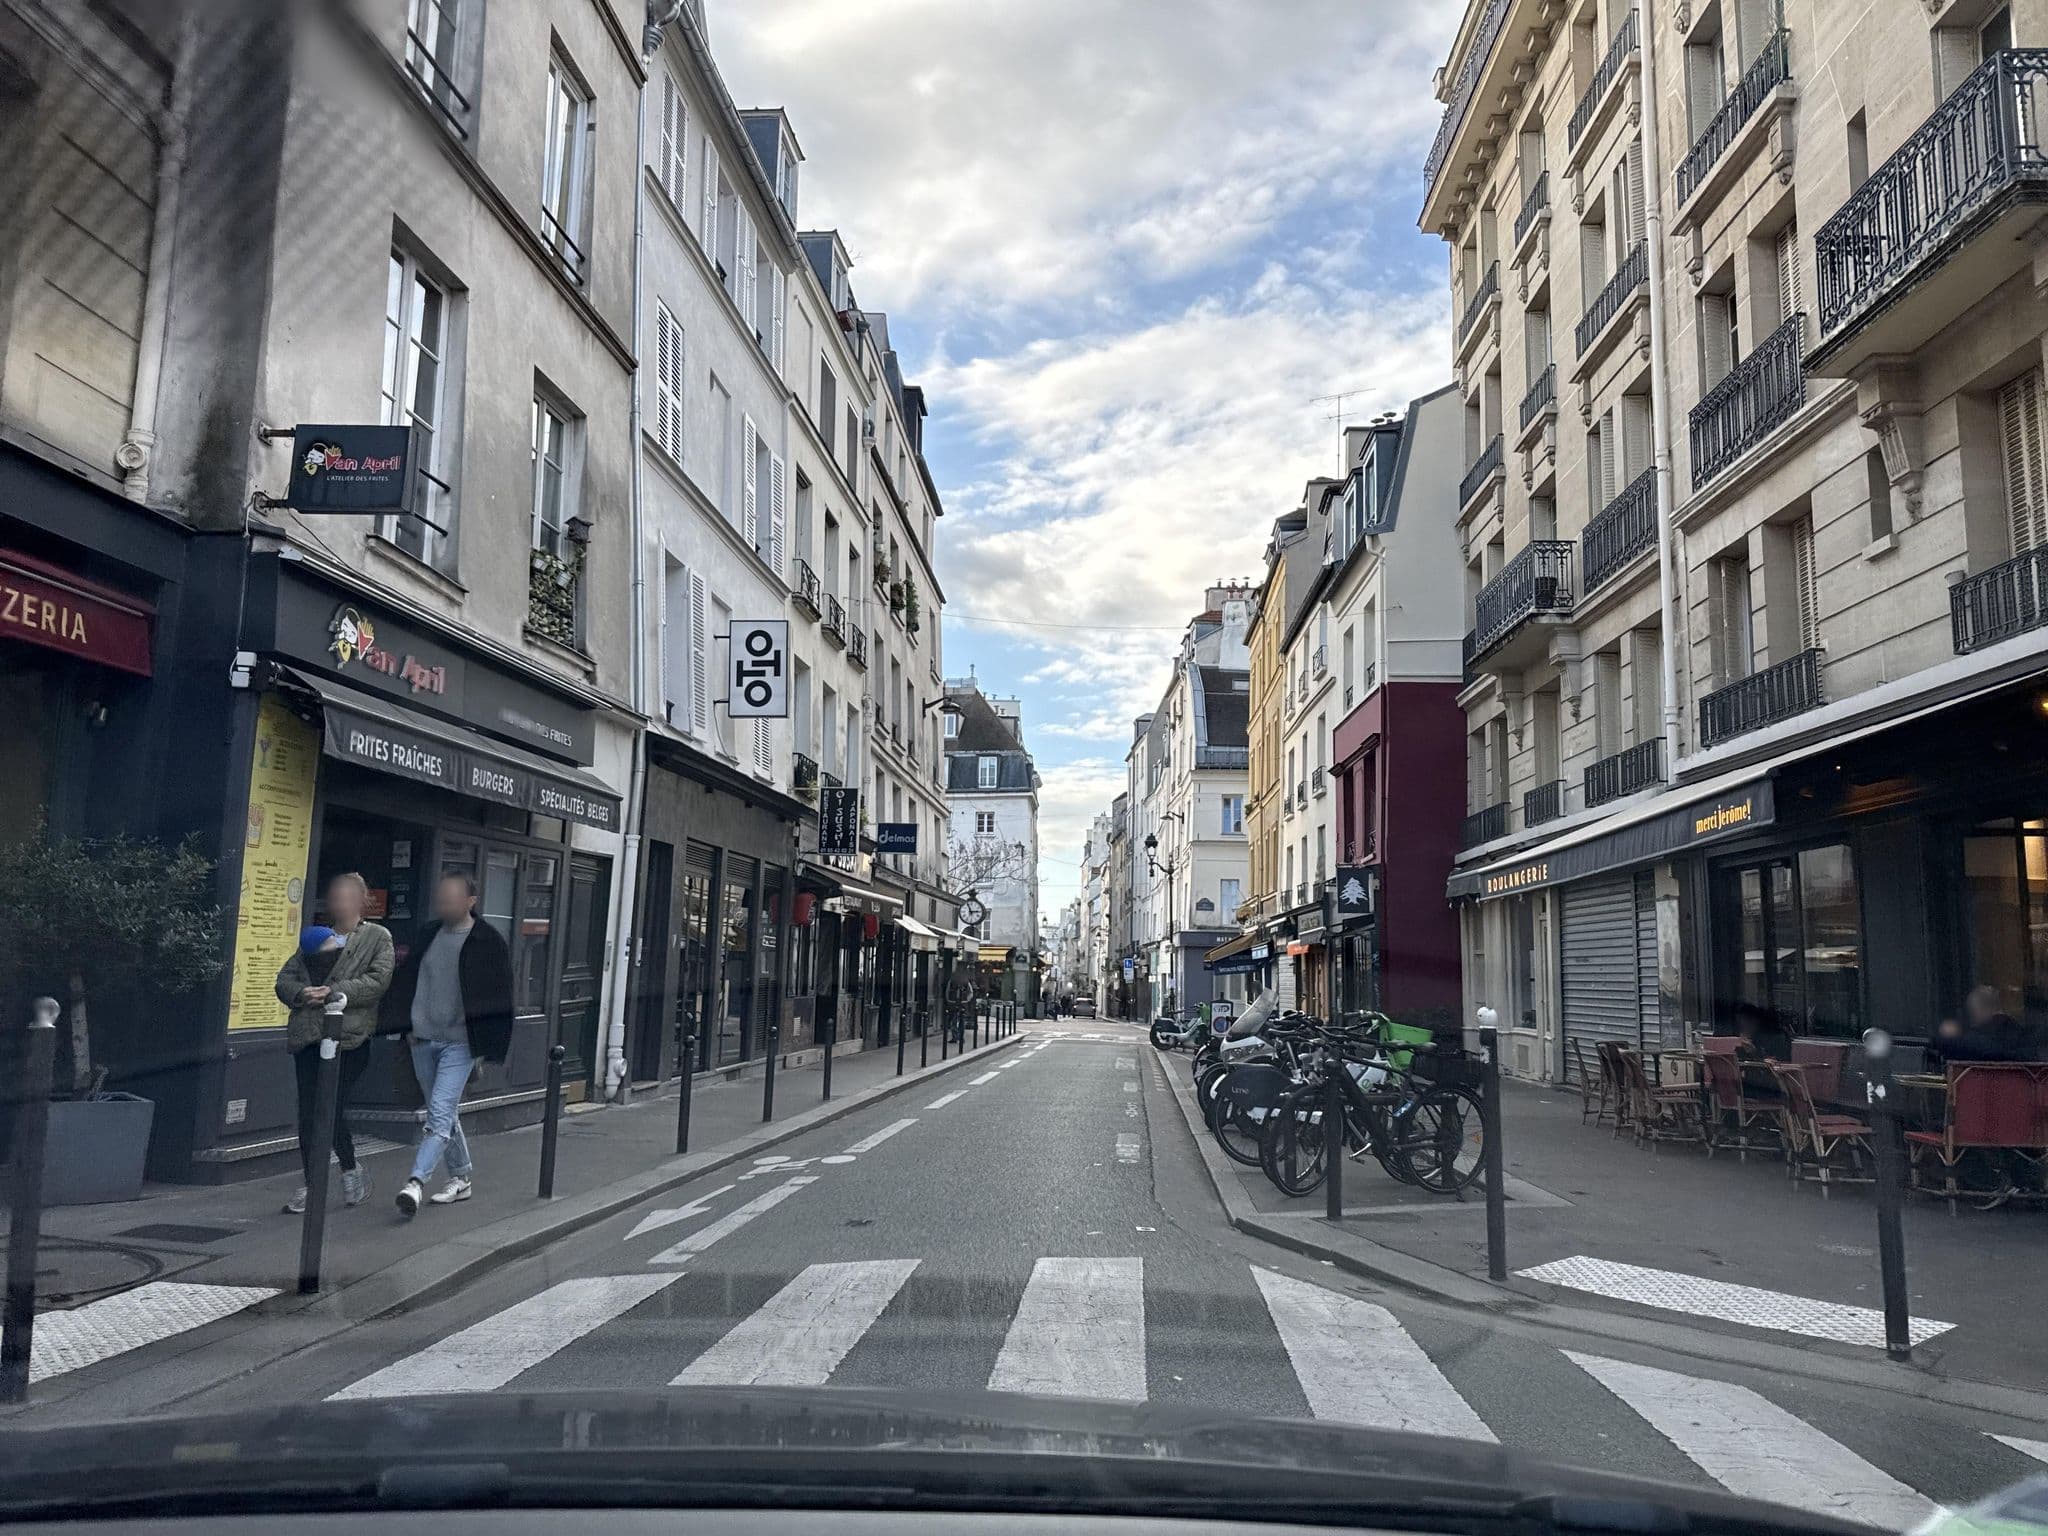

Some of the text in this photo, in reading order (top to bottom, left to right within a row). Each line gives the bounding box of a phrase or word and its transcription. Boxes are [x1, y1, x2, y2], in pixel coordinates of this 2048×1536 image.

[324, 448, 401, 473] Van April
[0, 585, 87, 644] ZERIA
[399, 655, 446, 694] April
[736, 630, 781, 707] OTTO
[349, 730, 442, 776] FRITES FRAÎCHES
[550, 729, 572, 747] FRITES
[472, 767, 514, 796] BURGERS
[540, 787, 609, 822] SPÉCIALITÉS BELGES
[879, 830, 915, 844] delmas
[1696, 810, 1718, 834] merci
